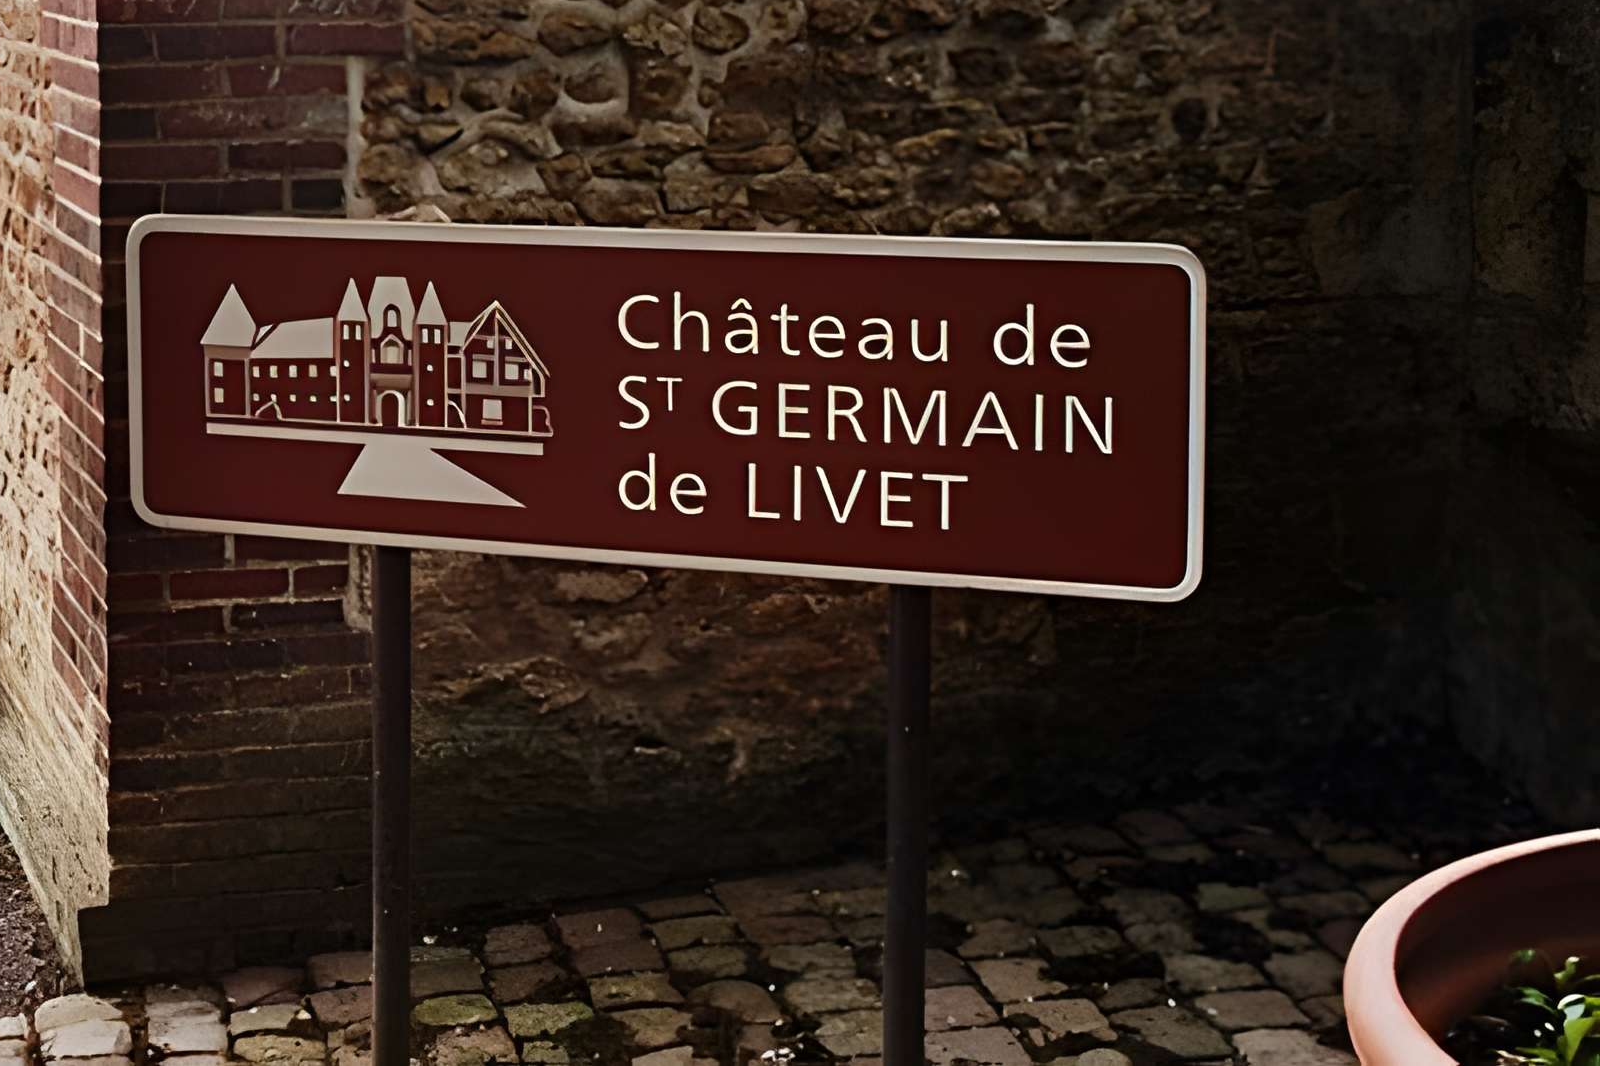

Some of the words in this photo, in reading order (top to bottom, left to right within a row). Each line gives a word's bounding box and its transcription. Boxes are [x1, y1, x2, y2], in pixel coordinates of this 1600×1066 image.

[616, 290, 951, 363] Château
[992, 302, 1092, 369] de
[617, 374, 684, 431] ST
[710, 380, 1115, 456] GERMAIN
[617, 451, 709, 516] de
[747, 462, 970, 532] LIVET
